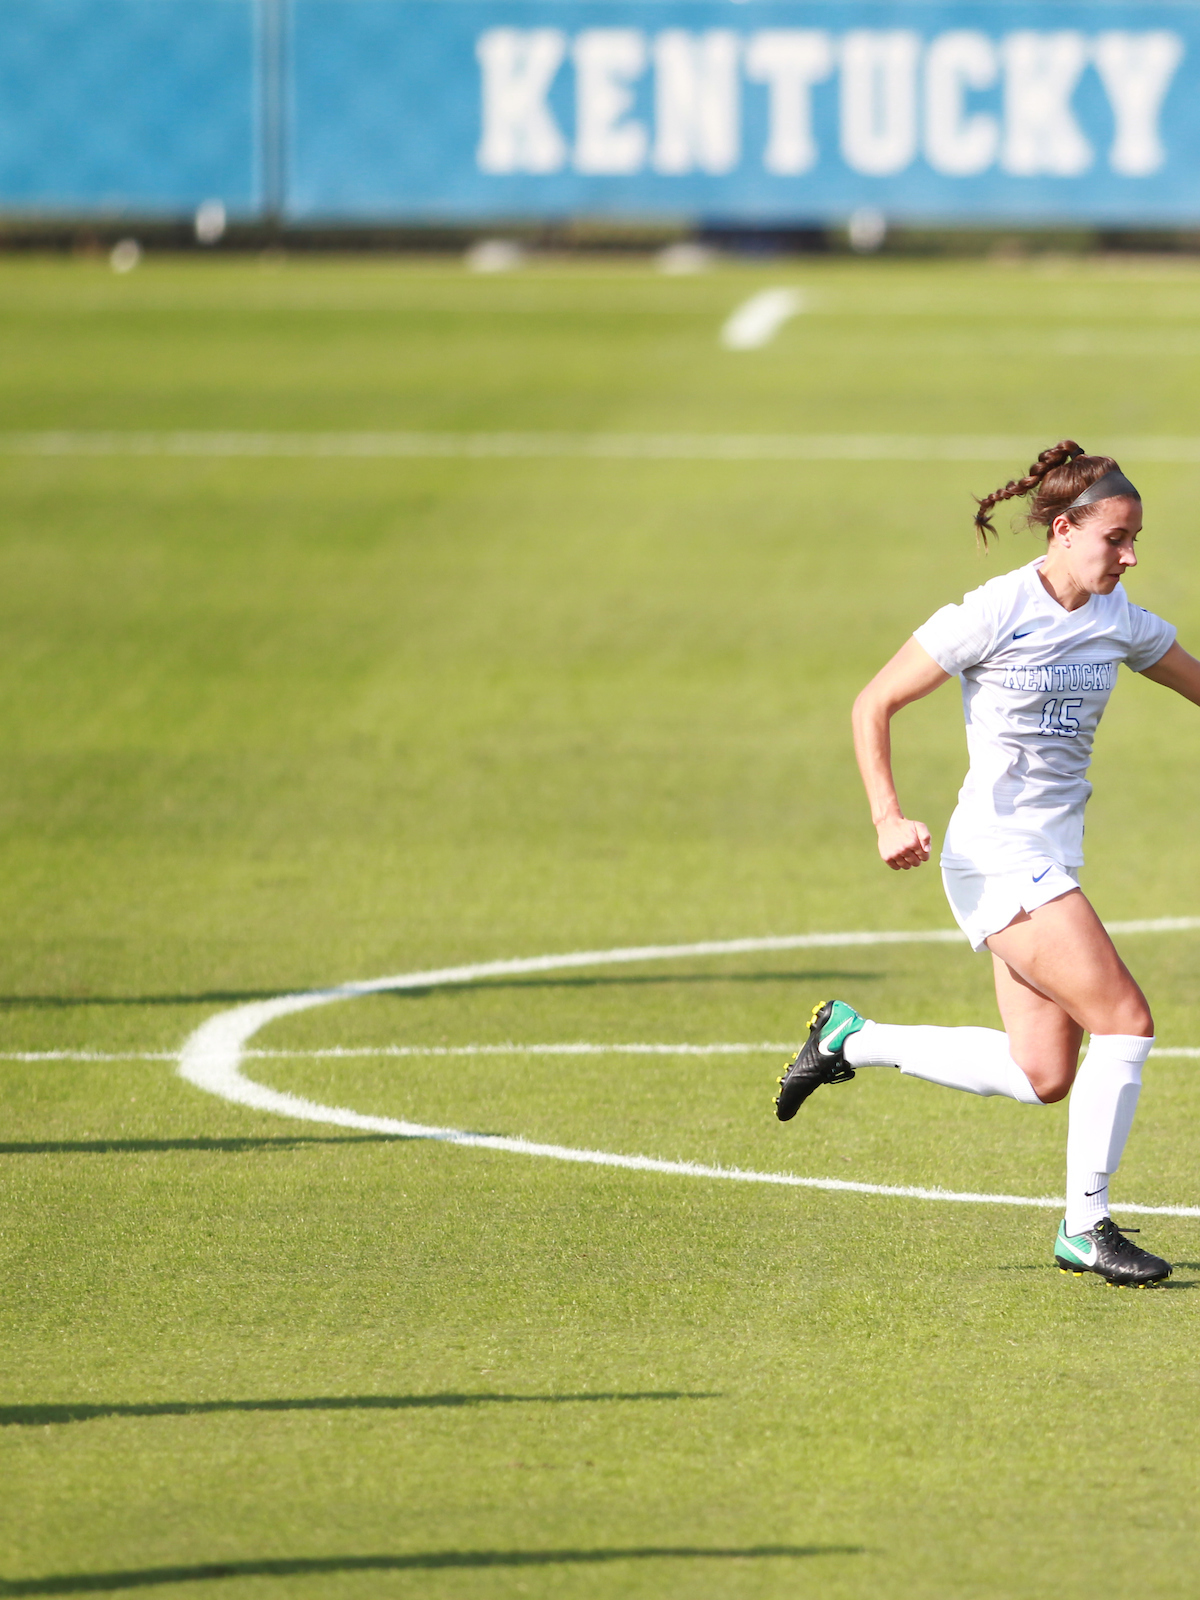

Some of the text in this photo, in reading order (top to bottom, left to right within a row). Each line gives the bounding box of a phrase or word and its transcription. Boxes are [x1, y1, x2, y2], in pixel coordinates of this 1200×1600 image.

[476, 28, 1184, 176] KENTUCKY
[1003, 663, 1112, 692] KENTUCKY
[1038, 698, 1083, 738] 15
